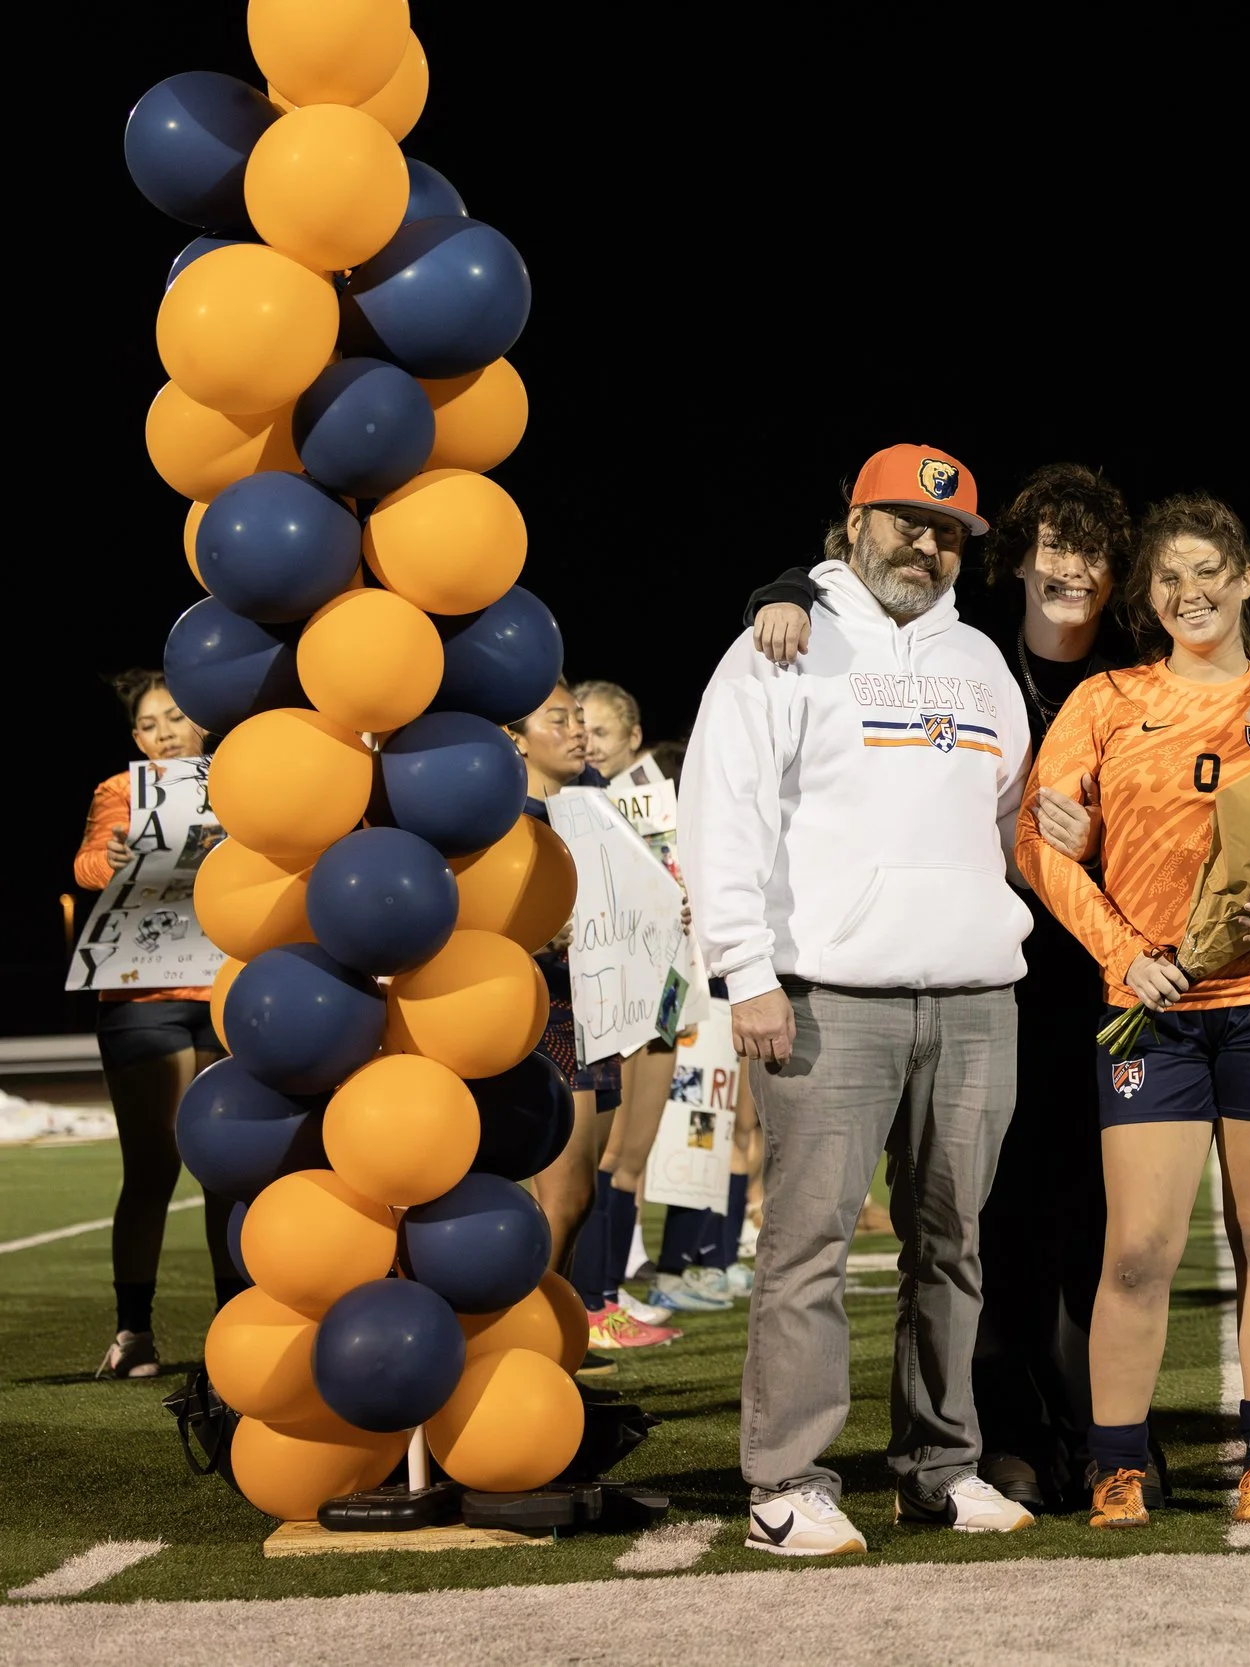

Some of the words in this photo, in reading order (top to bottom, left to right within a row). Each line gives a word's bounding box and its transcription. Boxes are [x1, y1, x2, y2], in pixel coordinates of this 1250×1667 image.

[849, 673, 965, 709] GRIZZLY
[966, 680, 997, 718] FC
[1194, 752, 1220, 793] 0
[78, 765, 172, 990] BAILEY
